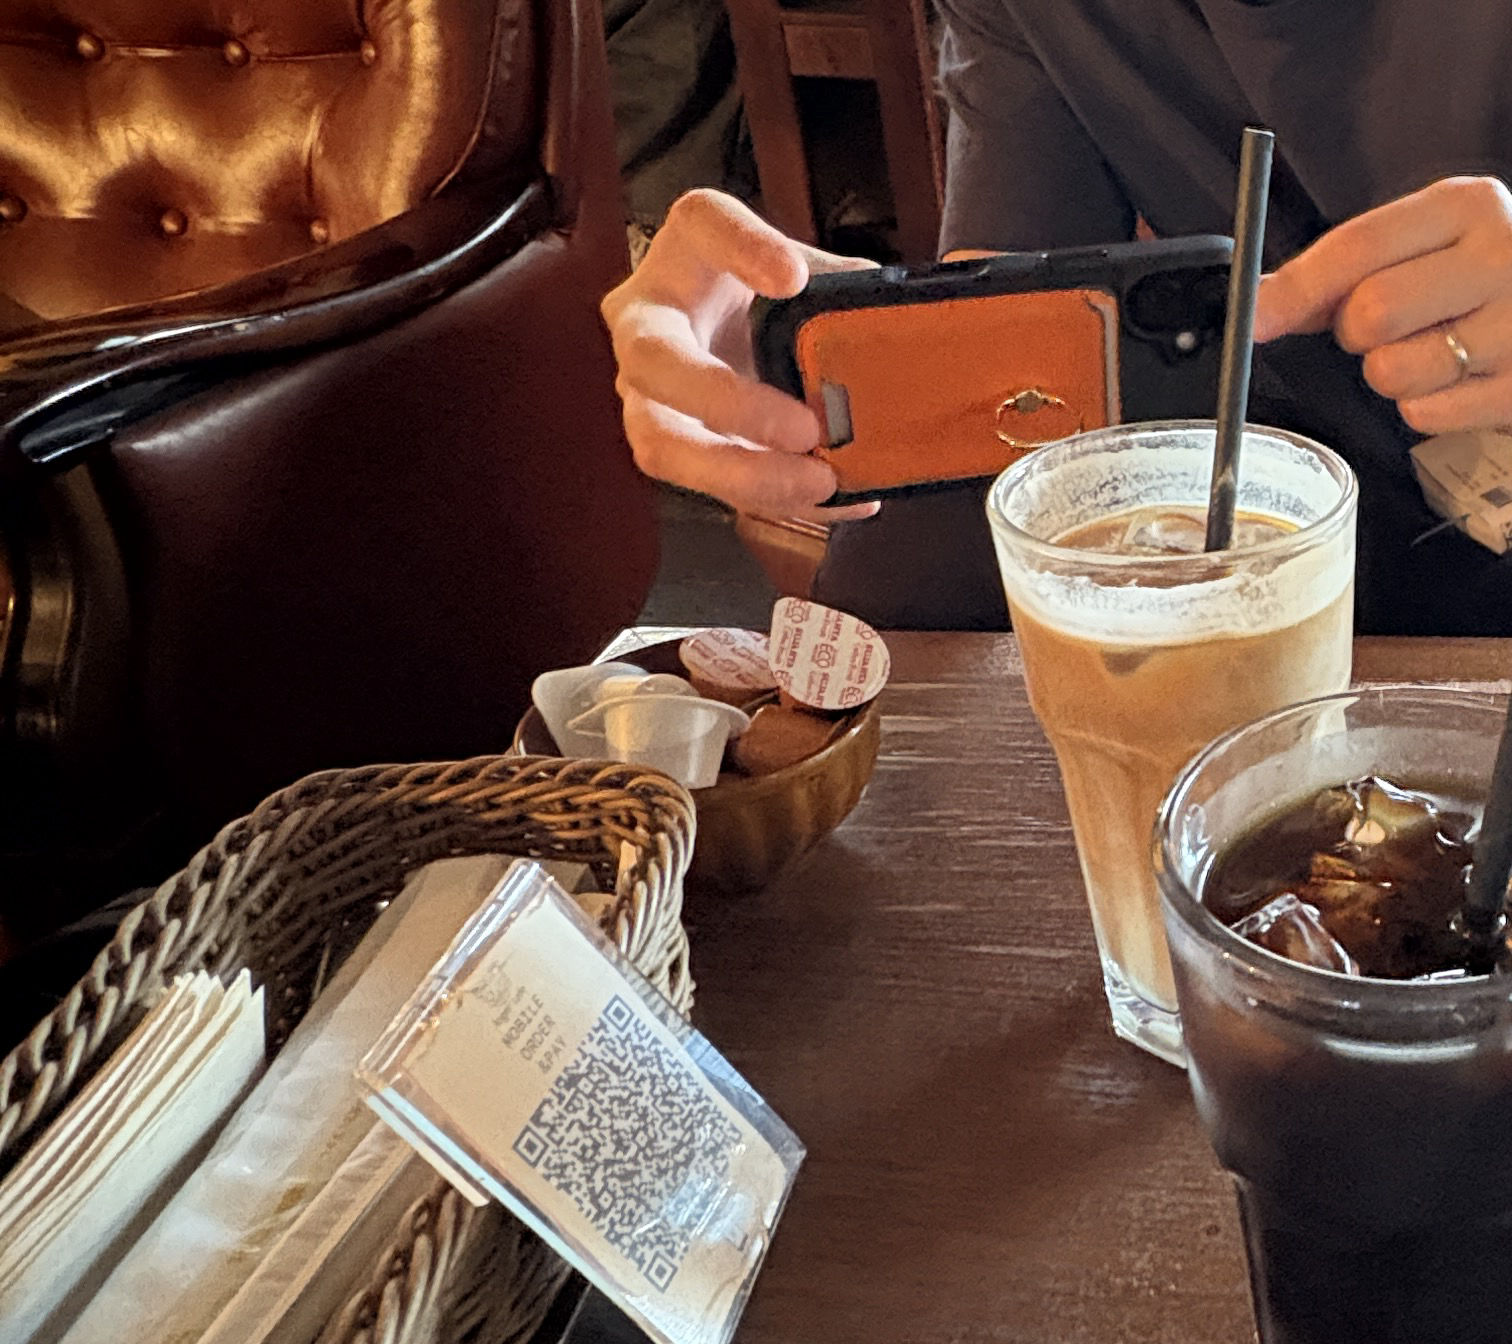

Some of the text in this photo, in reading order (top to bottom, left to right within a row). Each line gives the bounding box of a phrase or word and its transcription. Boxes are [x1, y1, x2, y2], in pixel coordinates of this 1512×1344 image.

[816, 643, 833, 668] ECO
[502, 994, 543, 1049] MOBILE
[520, 1014, 555, 1060] ORDER
[538, 1035, 566, 1073] &PAY
